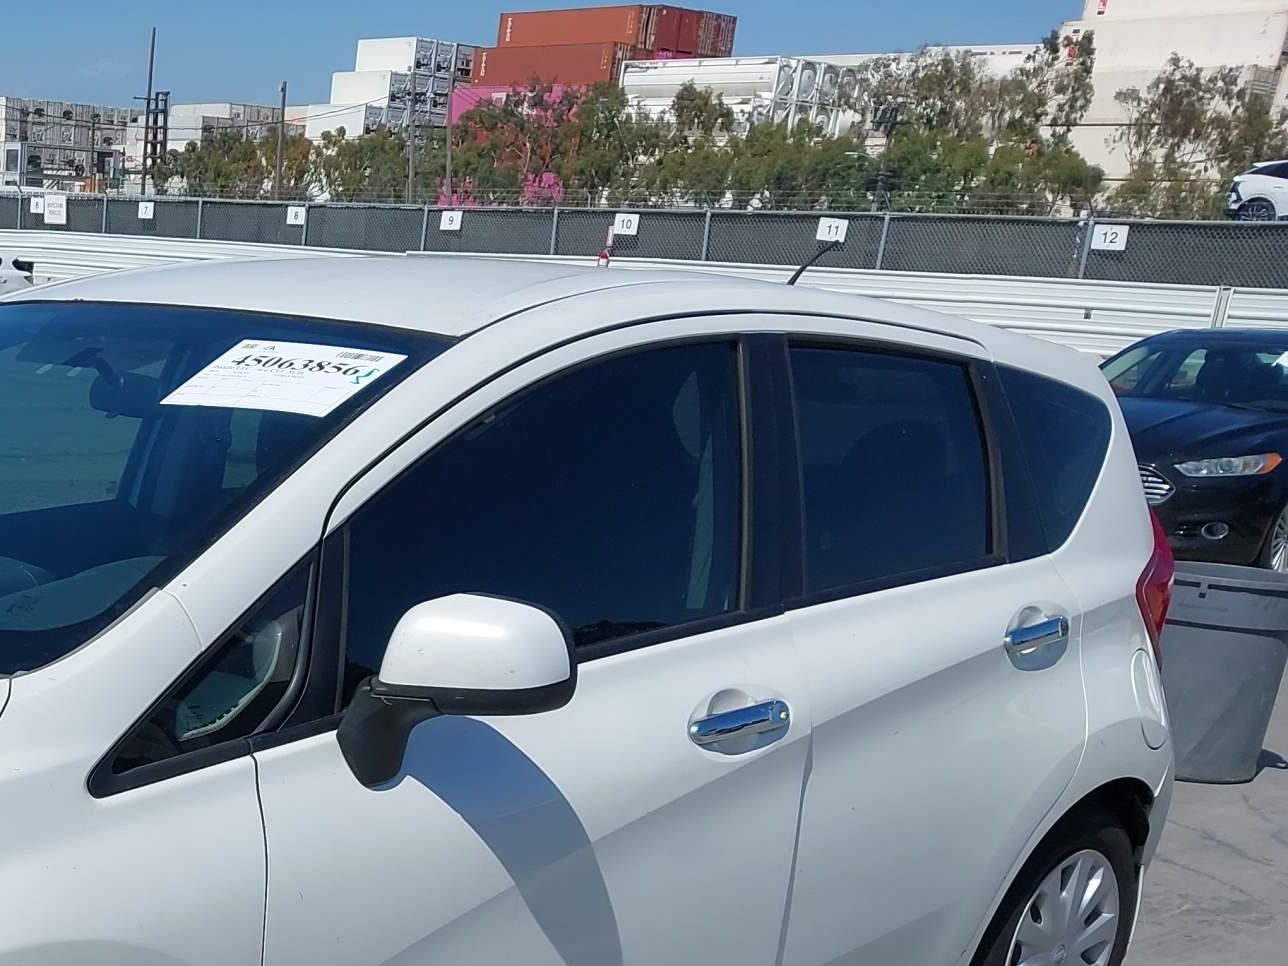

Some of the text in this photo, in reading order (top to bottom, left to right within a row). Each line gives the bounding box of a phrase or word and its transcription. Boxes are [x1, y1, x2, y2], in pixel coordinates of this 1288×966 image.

[144, 206, 149, 215] 7
[293, 210, 299, 220] 8
[448, 215, 454, 225] 9
[621, 218, 632, 230] 10
[827, 224, 839, 236] 11
[1102, 231, 1118, 244] 12
[231, 354, 361, 377] 45063856
